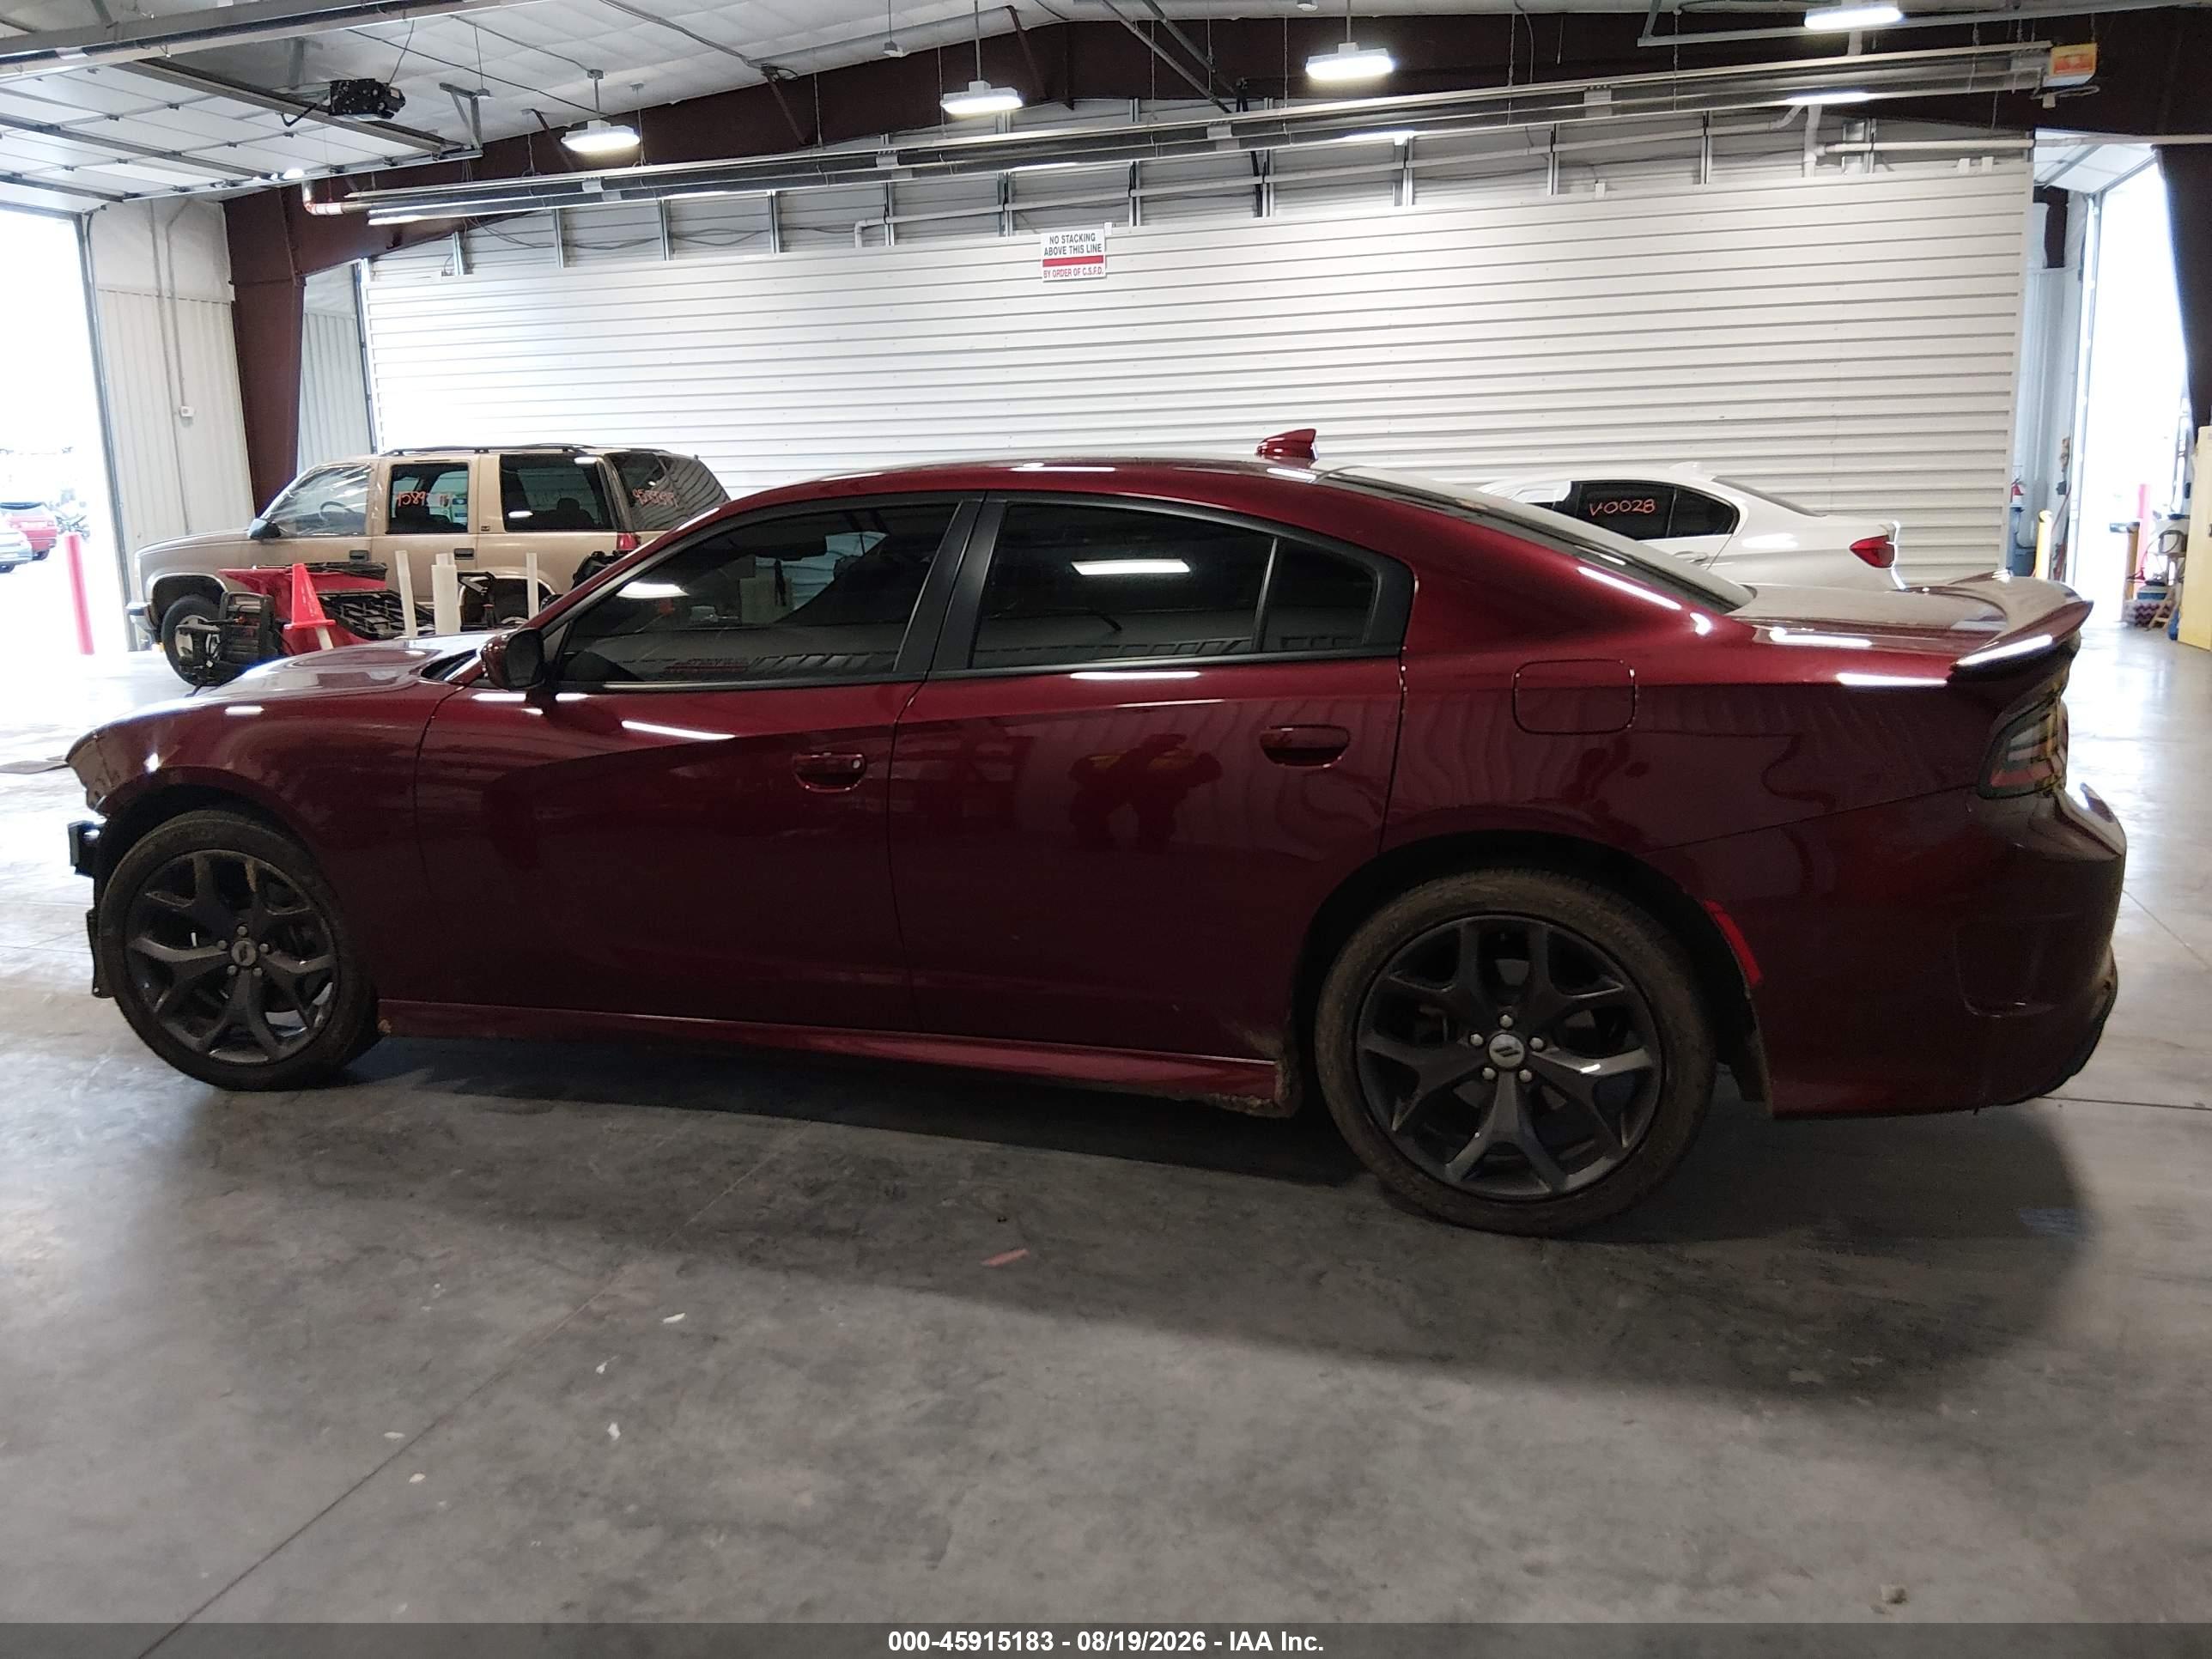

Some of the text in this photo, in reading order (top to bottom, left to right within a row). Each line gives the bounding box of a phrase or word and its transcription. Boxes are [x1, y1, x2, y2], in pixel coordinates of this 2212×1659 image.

[1049, 233, 1096, 245] NO STACKING
[1044, 243, 1102, 256] ABOVE THIS LINE
[1043, 270, 1051, 278] BY
[1052, 268, 1073, 278] ORDER
[1073, 267, 1081, 276] OF
